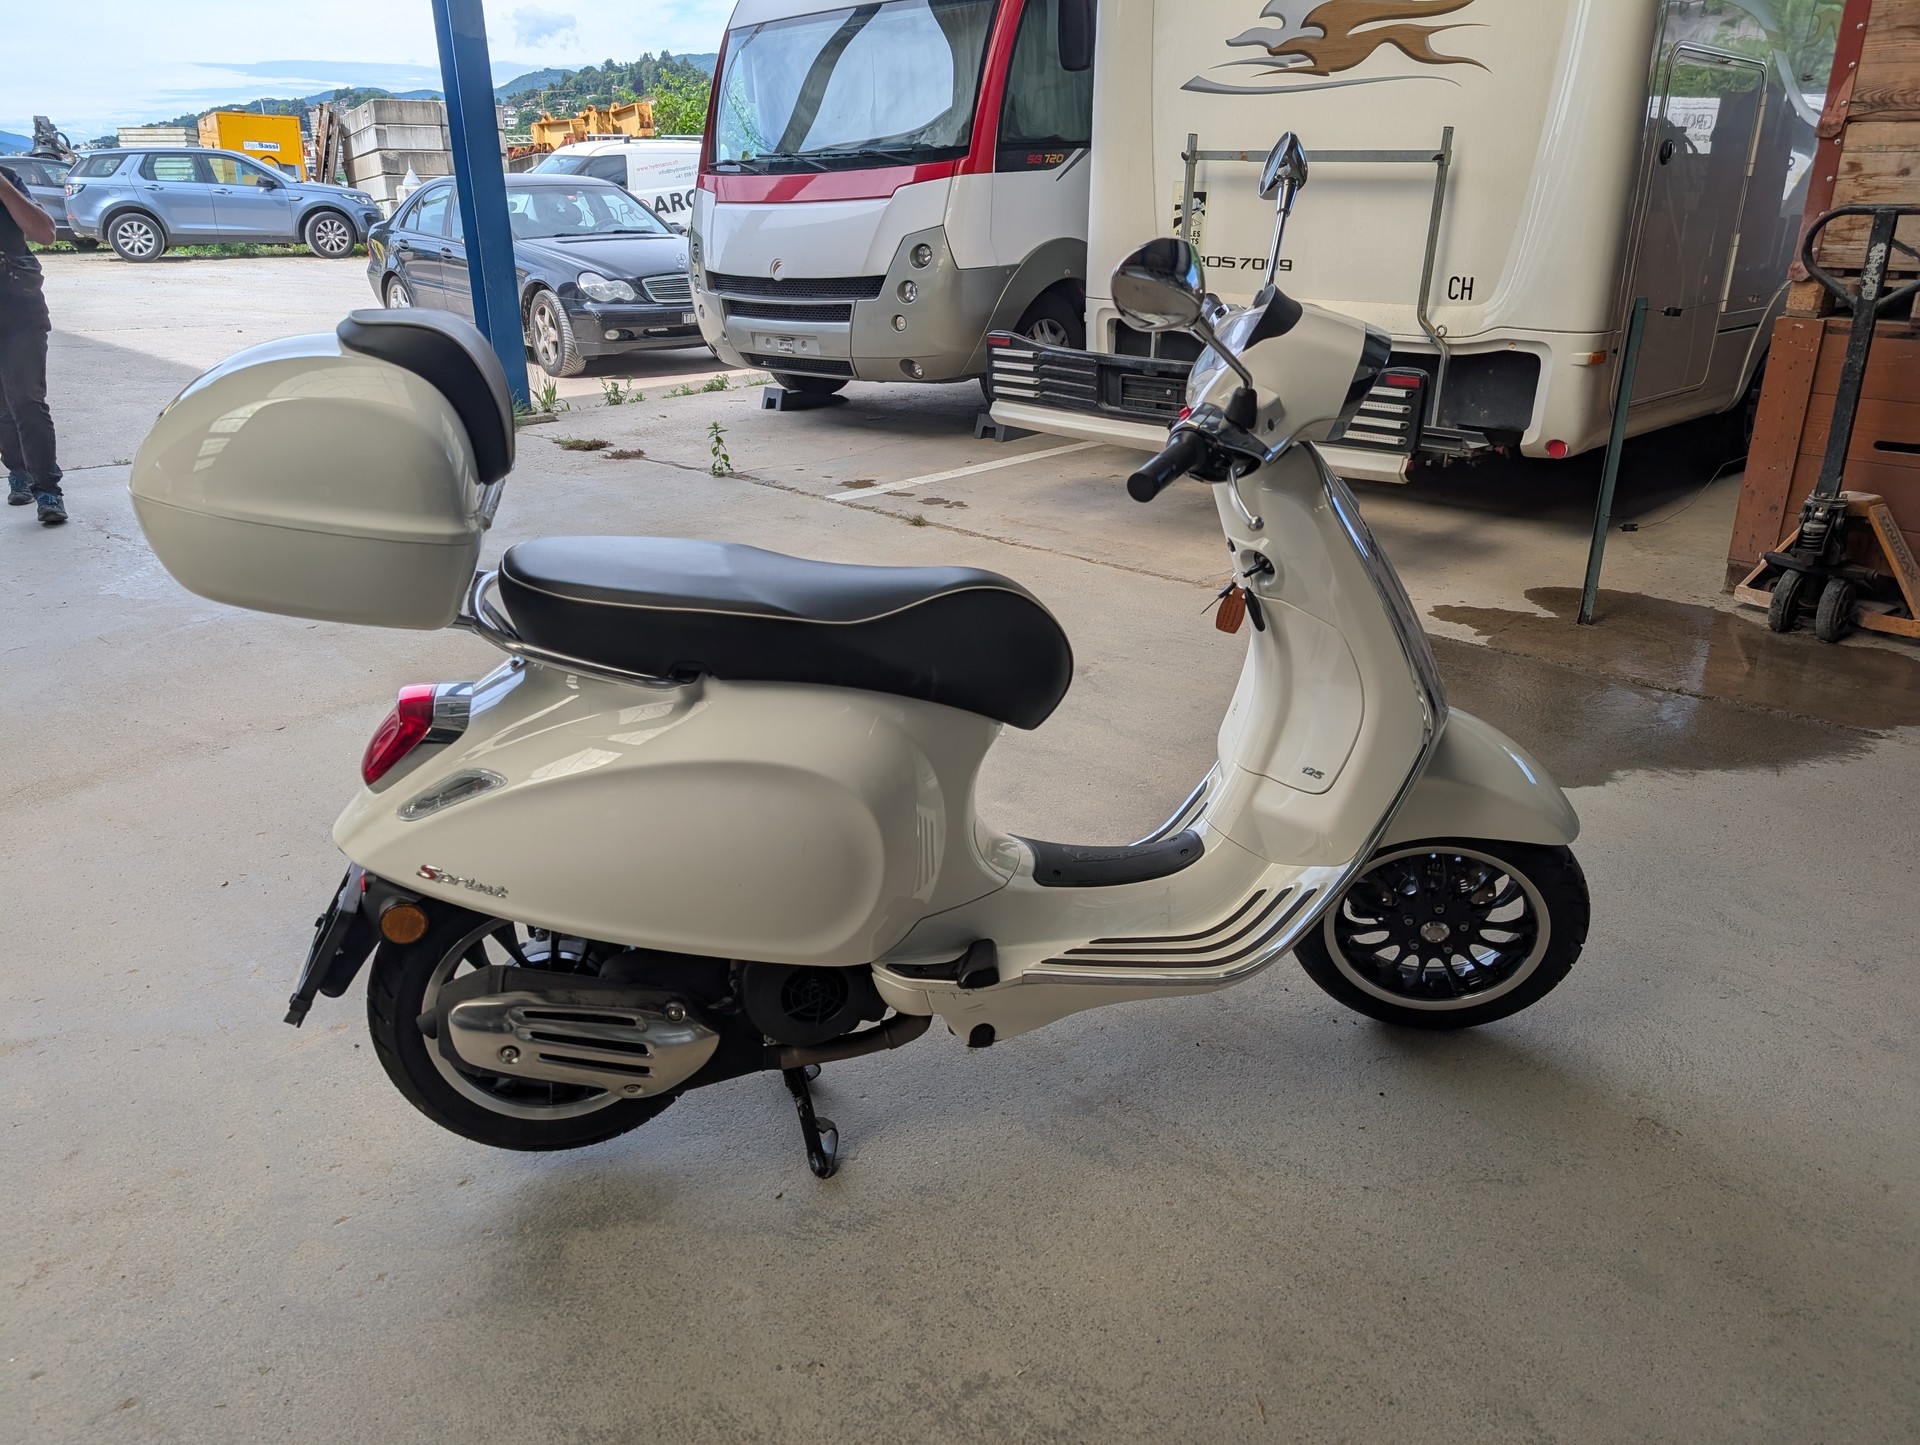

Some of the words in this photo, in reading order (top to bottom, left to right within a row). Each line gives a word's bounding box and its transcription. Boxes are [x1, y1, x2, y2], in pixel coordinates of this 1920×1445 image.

[1045, 154, 1064, 164] 720
[1448, 276, 1474, 301] CH
[1302, 766, 1325, 780] 125
[416, 864, 509, 898] Sprint
